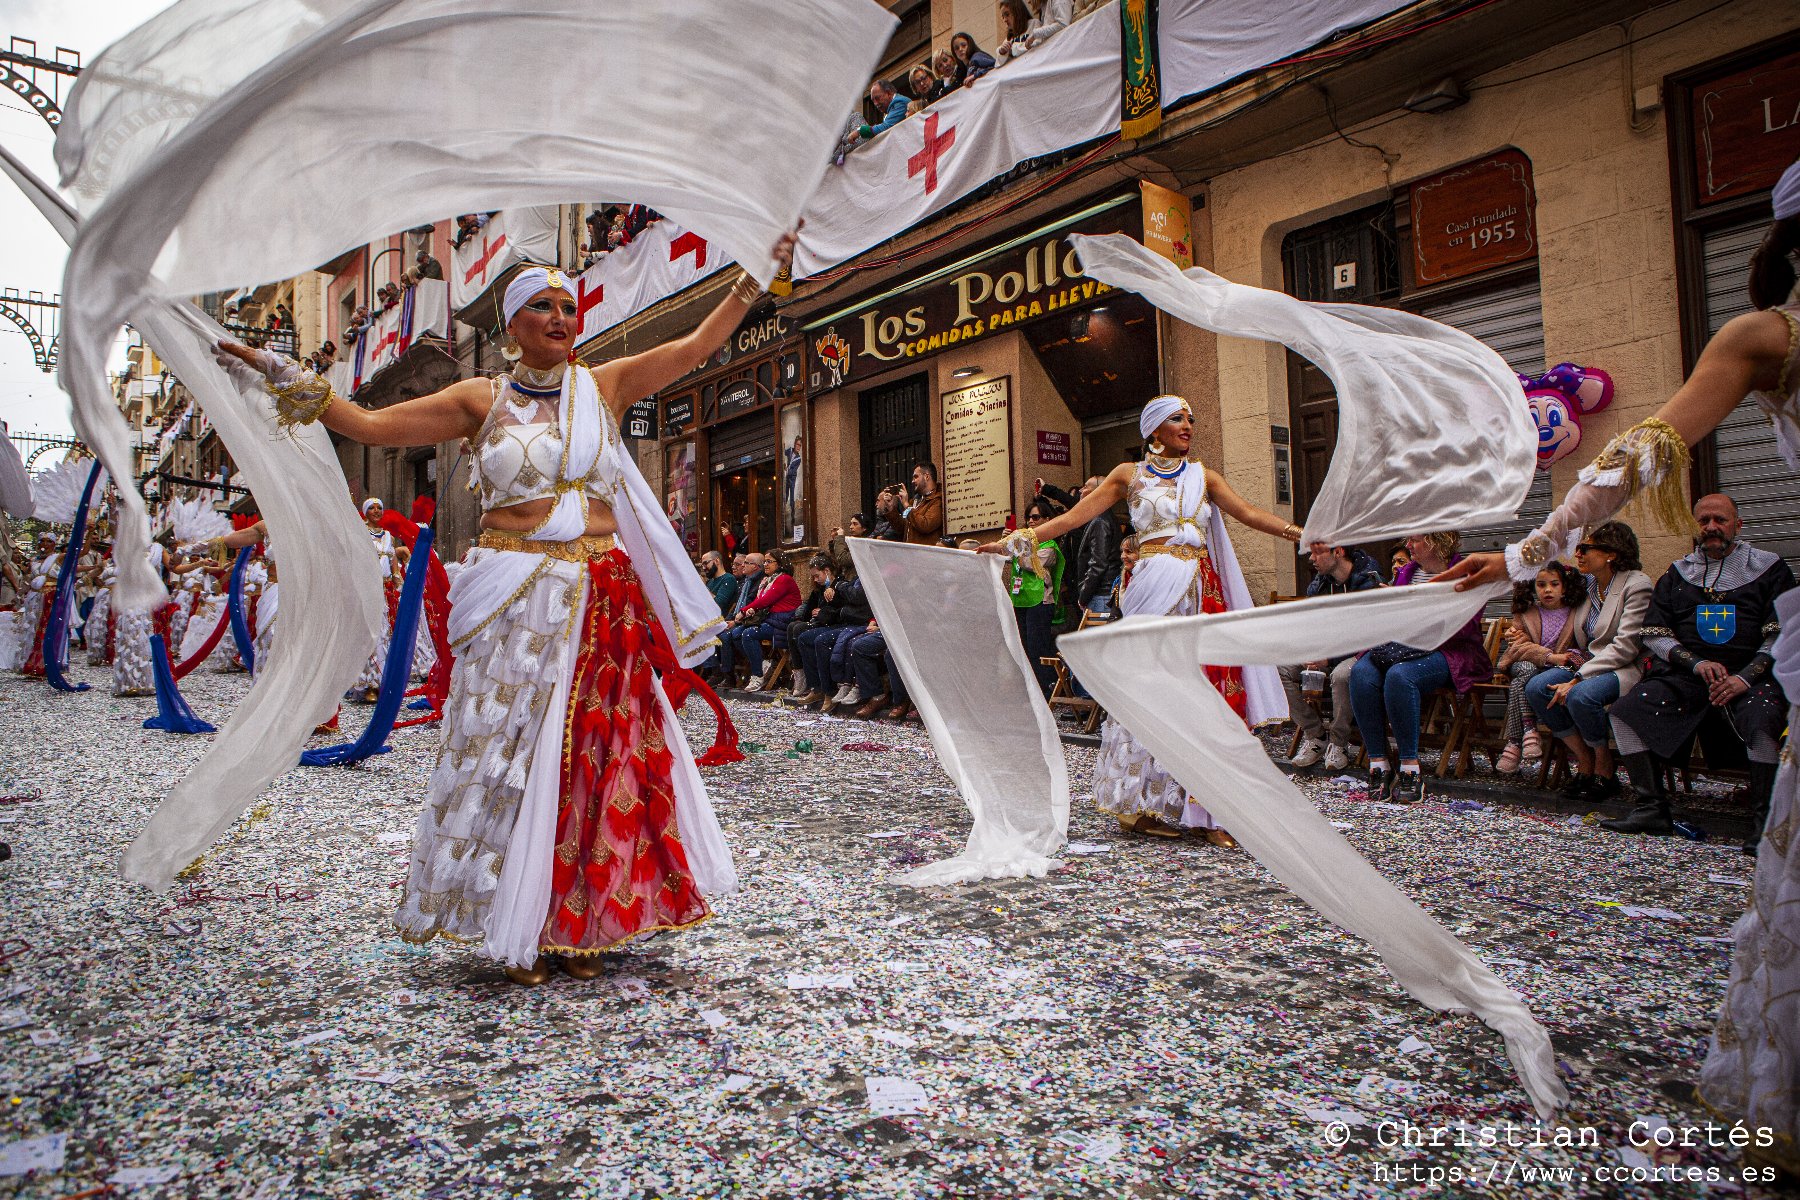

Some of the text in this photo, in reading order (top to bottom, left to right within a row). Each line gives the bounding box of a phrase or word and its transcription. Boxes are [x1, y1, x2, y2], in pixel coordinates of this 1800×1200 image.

[1446, 204, 1518, 235] Casa Fundada
[1448, 220, 1516, 250] en 1955
[1340, 268, 1348, 283] 6
[857, 238, 1086, 361] Los Pollo
[905, 281, 1120, 357] COMIDAS PARA LLEVA
[787, 363, 795, 379] 10
[945, 407, 974, 425] Comidas
